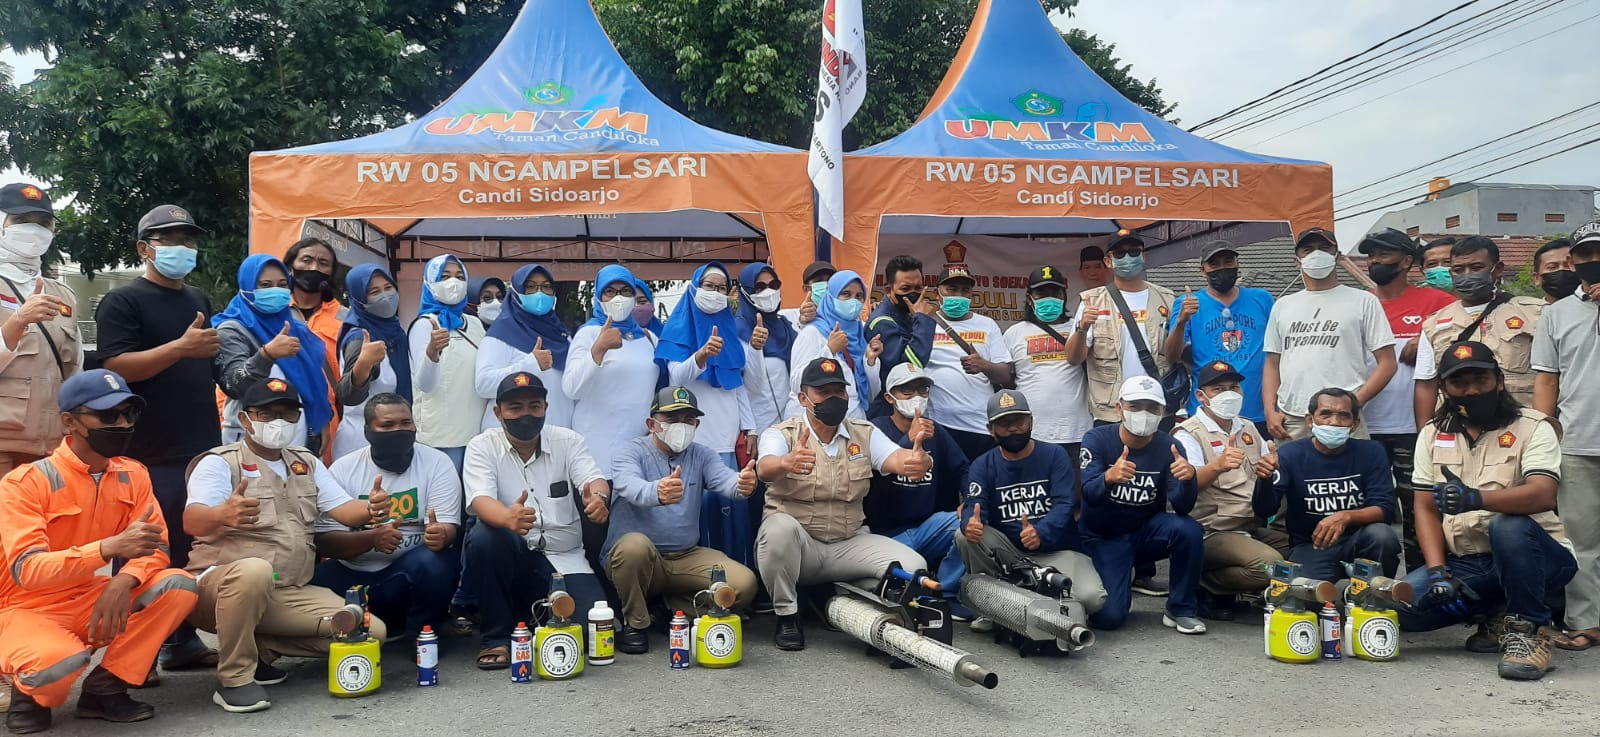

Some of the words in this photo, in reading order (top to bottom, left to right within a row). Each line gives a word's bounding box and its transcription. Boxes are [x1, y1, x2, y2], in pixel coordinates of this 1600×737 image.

[424, 107, 649, 136] UMKM
[494, 130, 559, 143] Taman
[563, 126, 661, 147] Candiloka
[945, 119, 1156, 143] UMKM
[1020, 139, 1081, 151] Taman
[1085, 141, 1178, 152] Candiloka
[357, 161, 411, 184] RW
[422, 162, 458, 184] 05
[469, 157, 707, 183] NGAMPELSARI
[925, 161, 975, 183] RW
[983, 163, 1016, 184] 05
[1025, 163, 1239, 188] NGAMPELSARI
[458, 187, 522, 204] Candi
[529, 187, 621, 205] Sidoarjo
[1016, 189, 1074, 205] Candi
[1079, 190, 1160, 209] Sidoarjo
[1042, 266, 1053, 280] 1
[970, 291, 1018, 309] DULI
[1313, 307, 1321, 319] I
[1205, 313, 1257, 335] SINGPORE
[1289, 321, 1321, 334] Must
[1321, 319, 1339, 331] Be
[1284, 333, 1341, 350] Dreaming
[1130, 475, 1156, 488] RJA
[1307, 480, 1360, 495] KERJA
[1001, 484, 1047, 502] KERJA
[1110, 485, 1158, 503] UNTAS
[1304, 492, 1365, 512] TUNTAS
[998, 498, 1053, 519] TUNTAS
[516, 650, 531, 661] GAS
